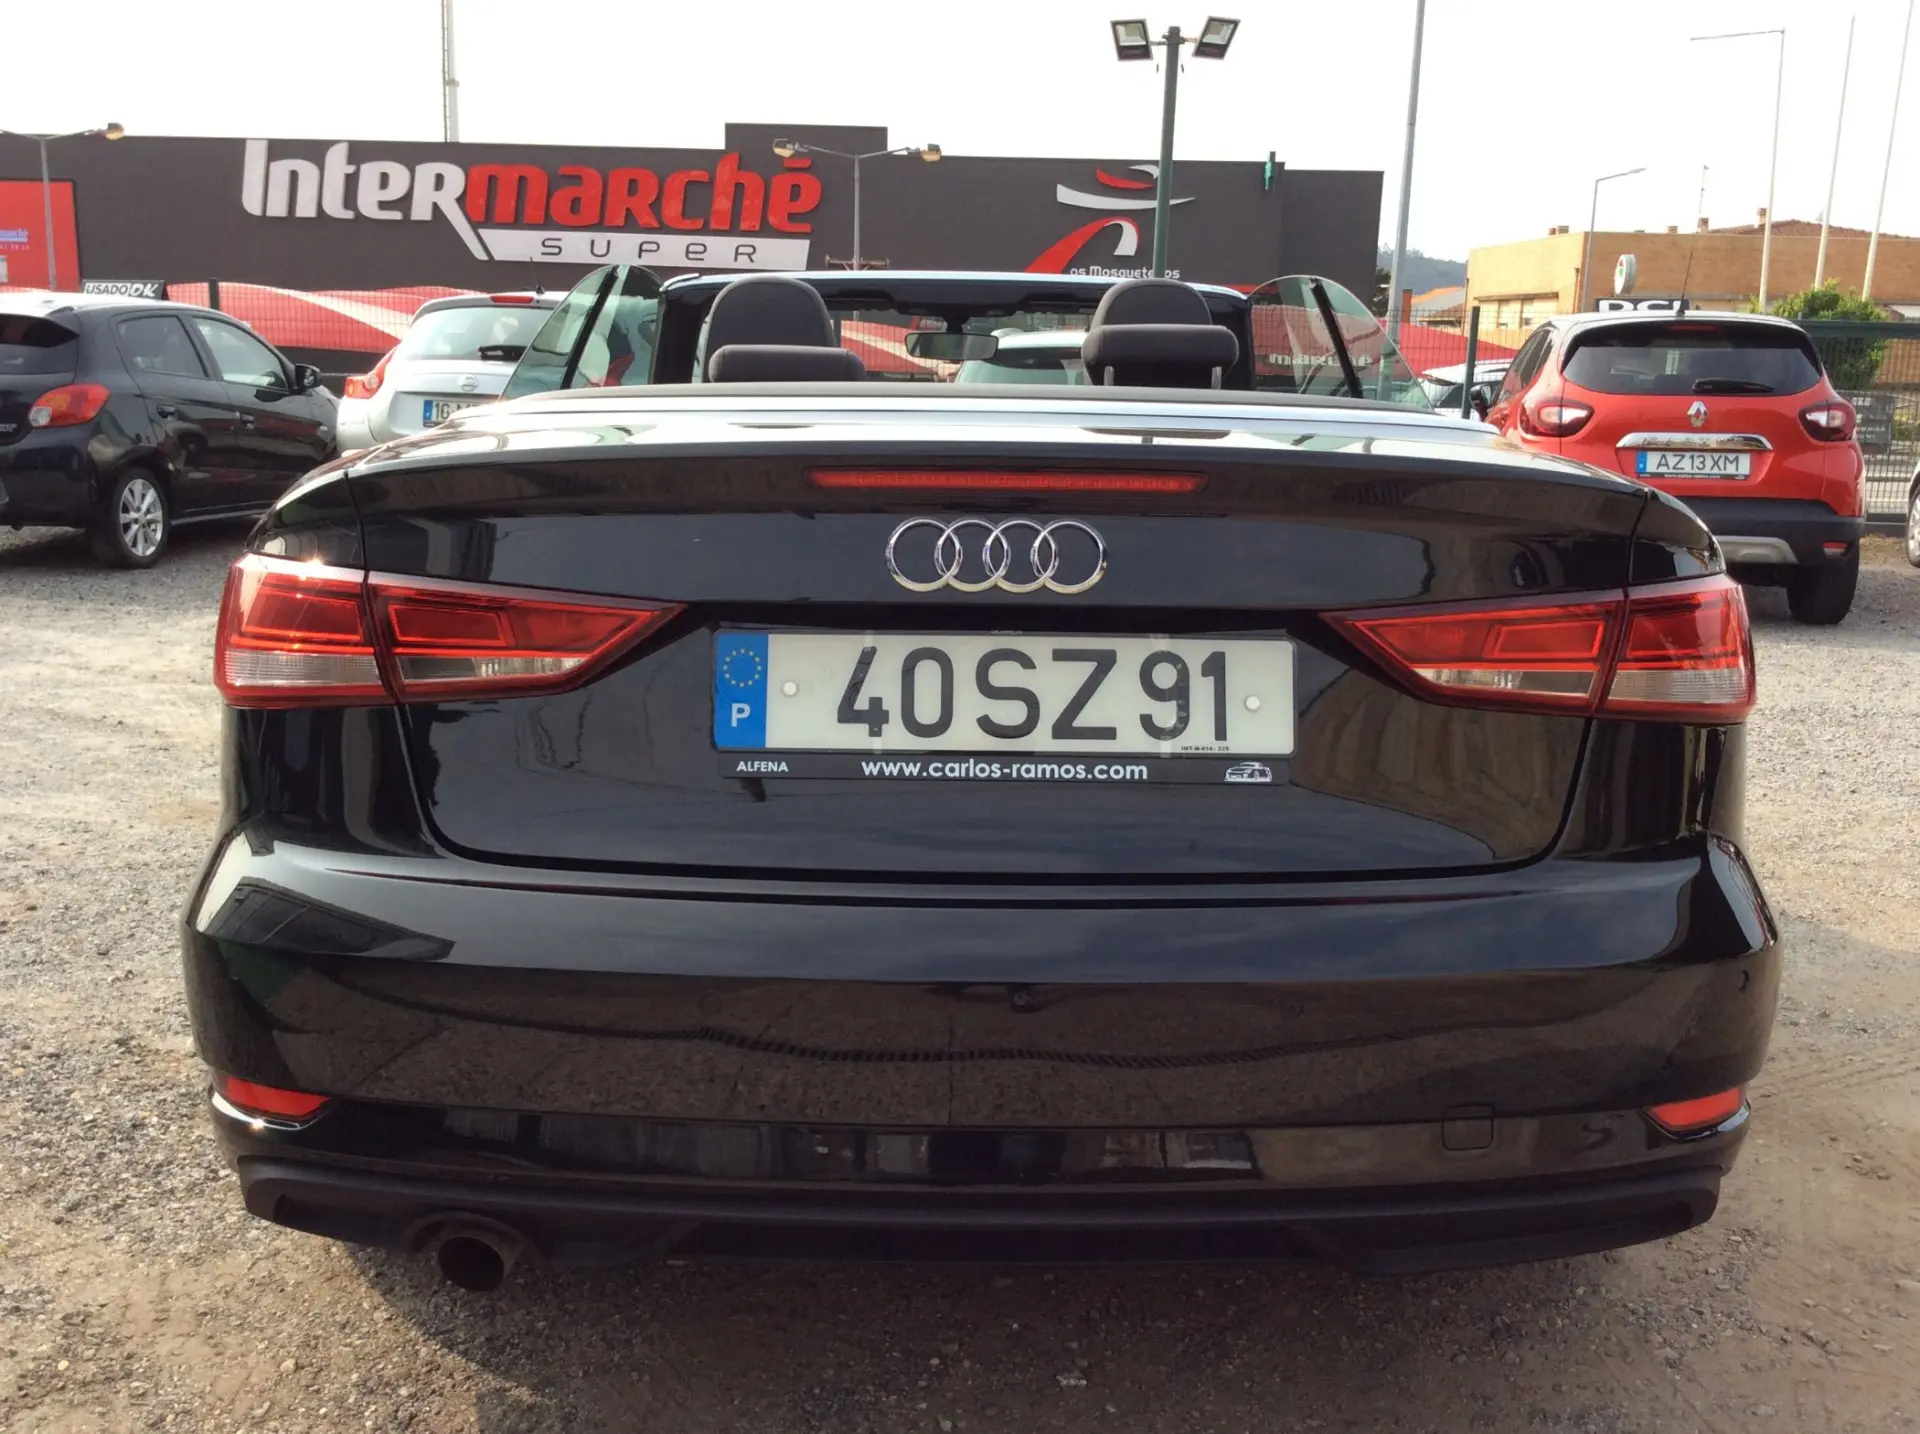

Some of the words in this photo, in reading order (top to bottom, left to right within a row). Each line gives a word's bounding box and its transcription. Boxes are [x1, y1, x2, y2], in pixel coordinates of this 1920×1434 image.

[1088, 265, 1181, 279] Mosqueteos
[730, 702, 751, 727] P
[736, 761, 789, 773] ALFENA
[861, 758, 1149, 780] www.carlos-ramos.com
